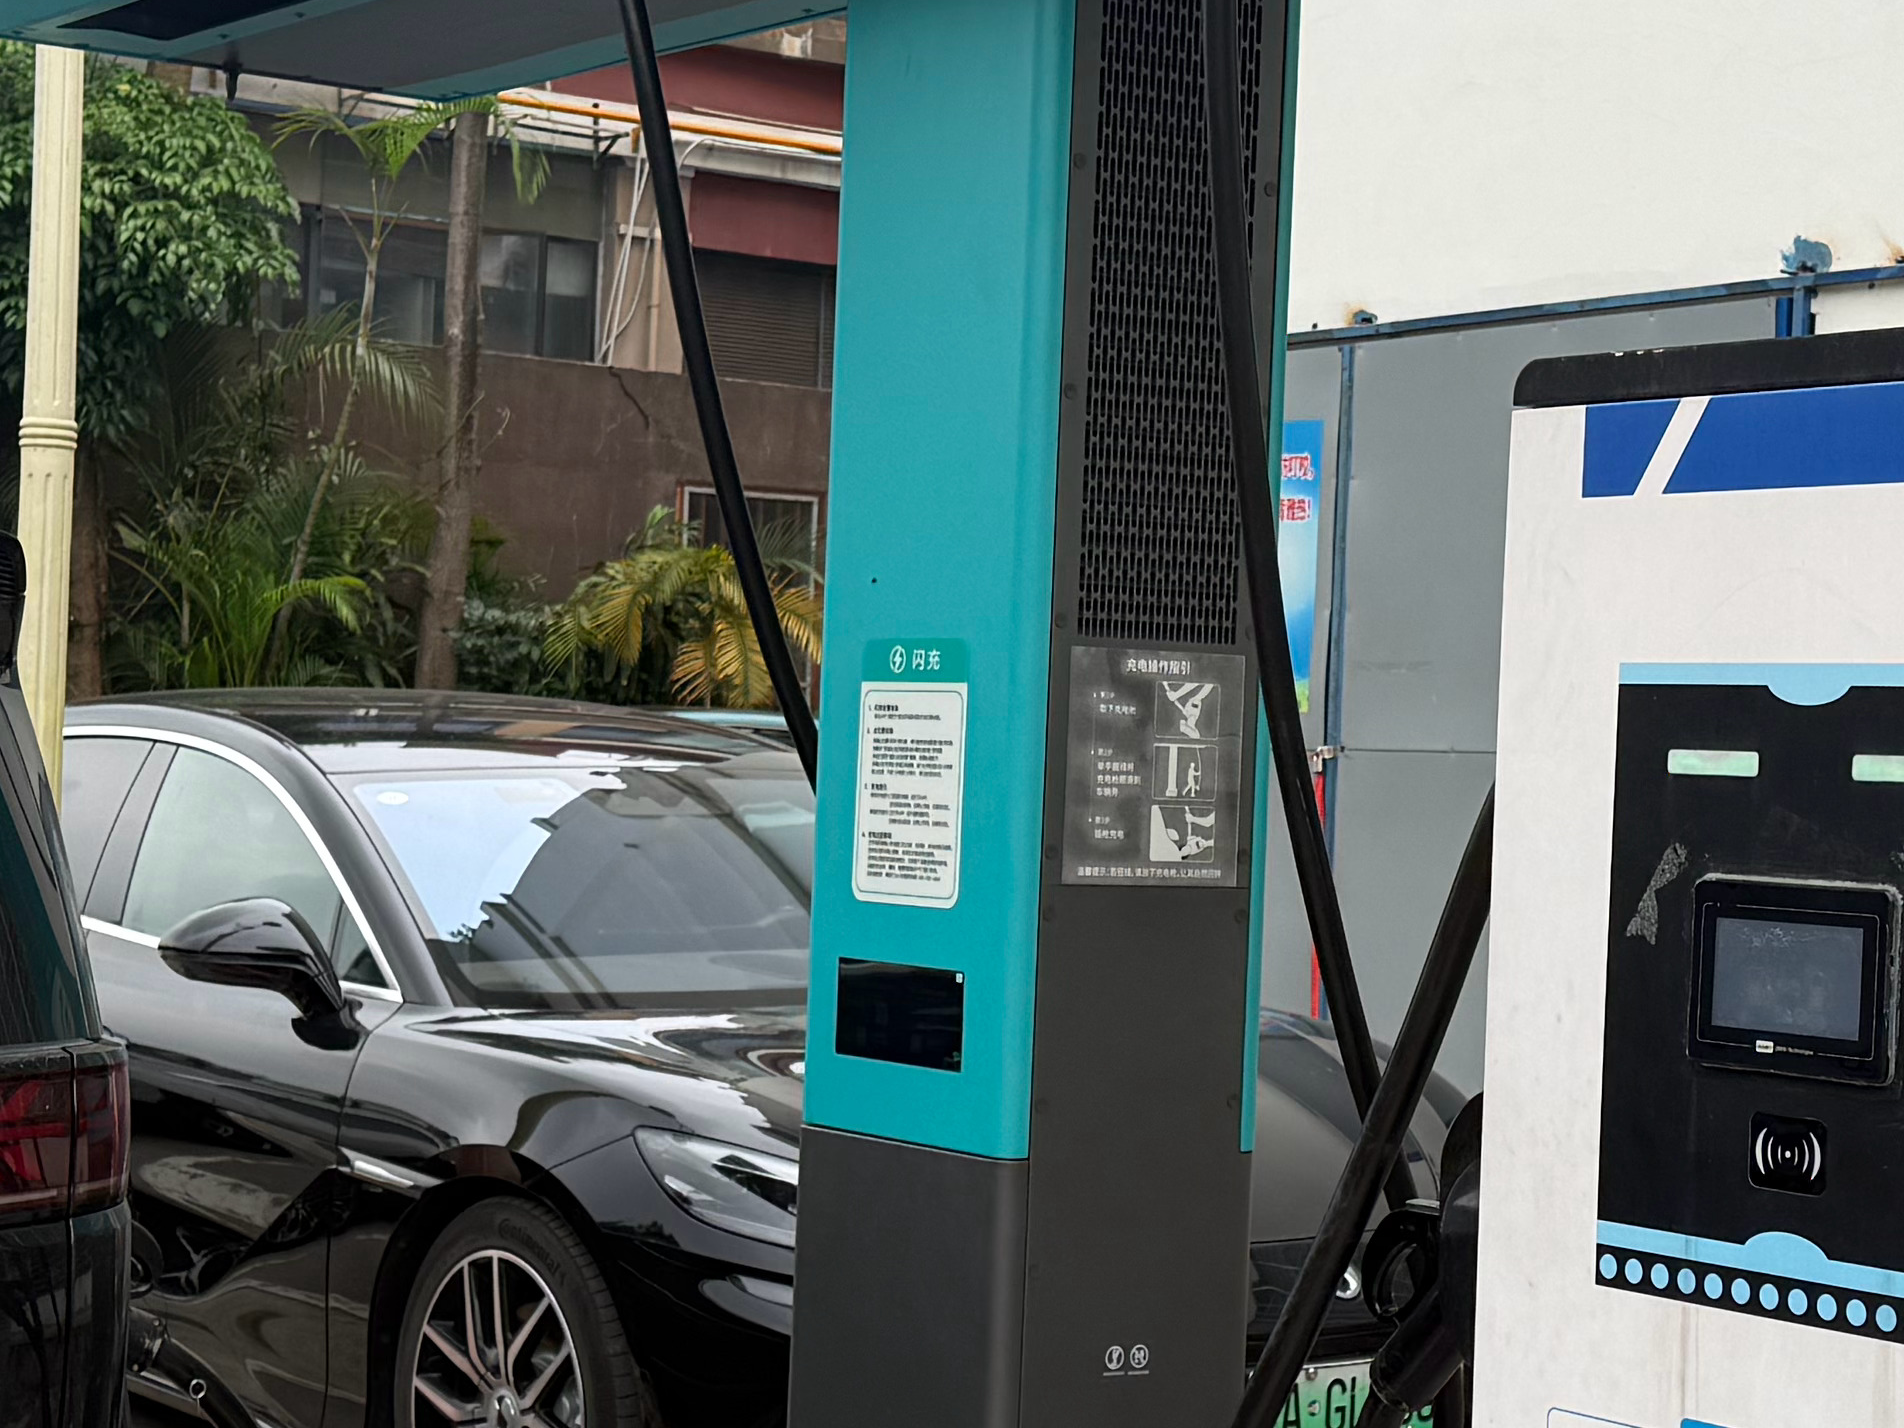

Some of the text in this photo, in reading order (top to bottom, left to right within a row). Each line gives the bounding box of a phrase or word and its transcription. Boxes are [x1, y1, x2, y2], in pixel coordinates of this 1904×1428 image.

[911, 648, 942, 671] 闪充
[1125, 658, 1191, 675] 充电操作指引
